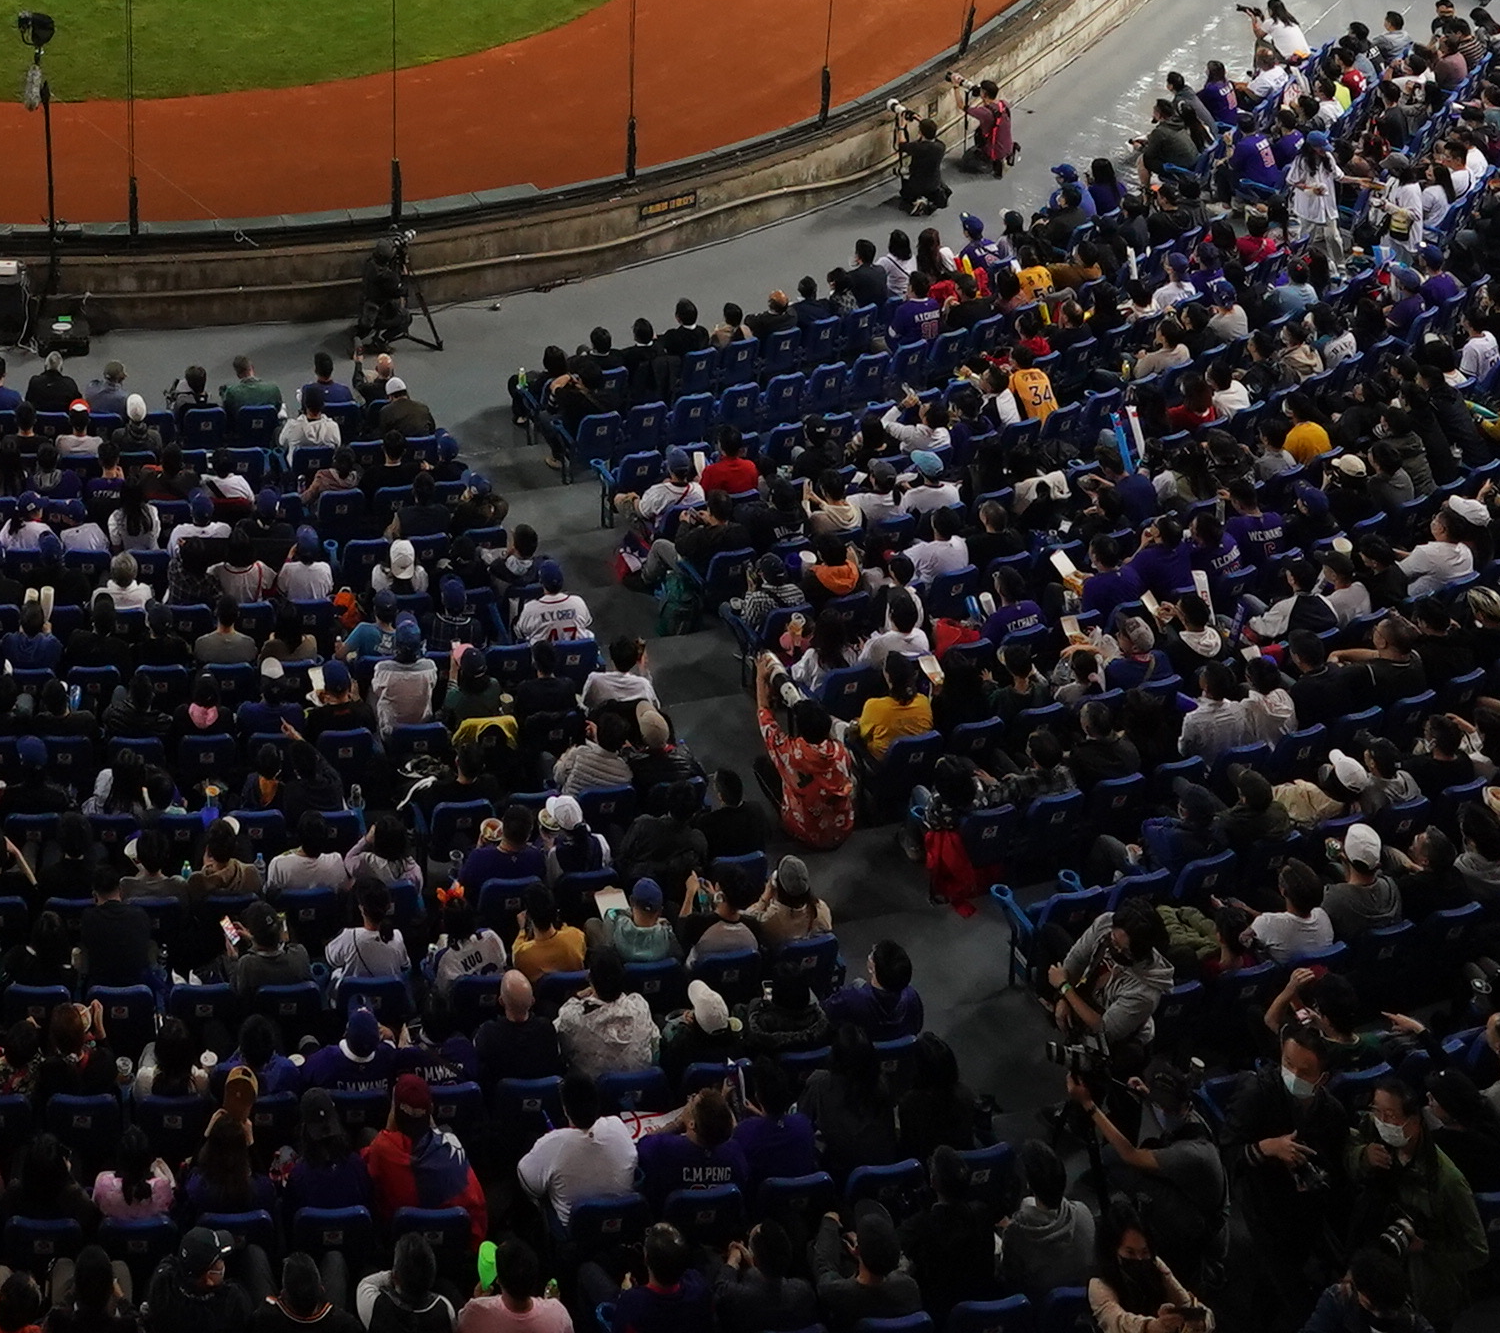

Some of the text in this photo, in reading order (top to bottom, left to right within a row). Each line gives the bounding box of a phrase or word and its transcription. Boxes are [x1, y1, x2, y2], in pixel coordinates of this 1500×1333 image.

[1028, 384, 1054, 407] 34
[460, 950, 483, 972] KUO
[682, 1166, 732, 1182] C.M.PENG
